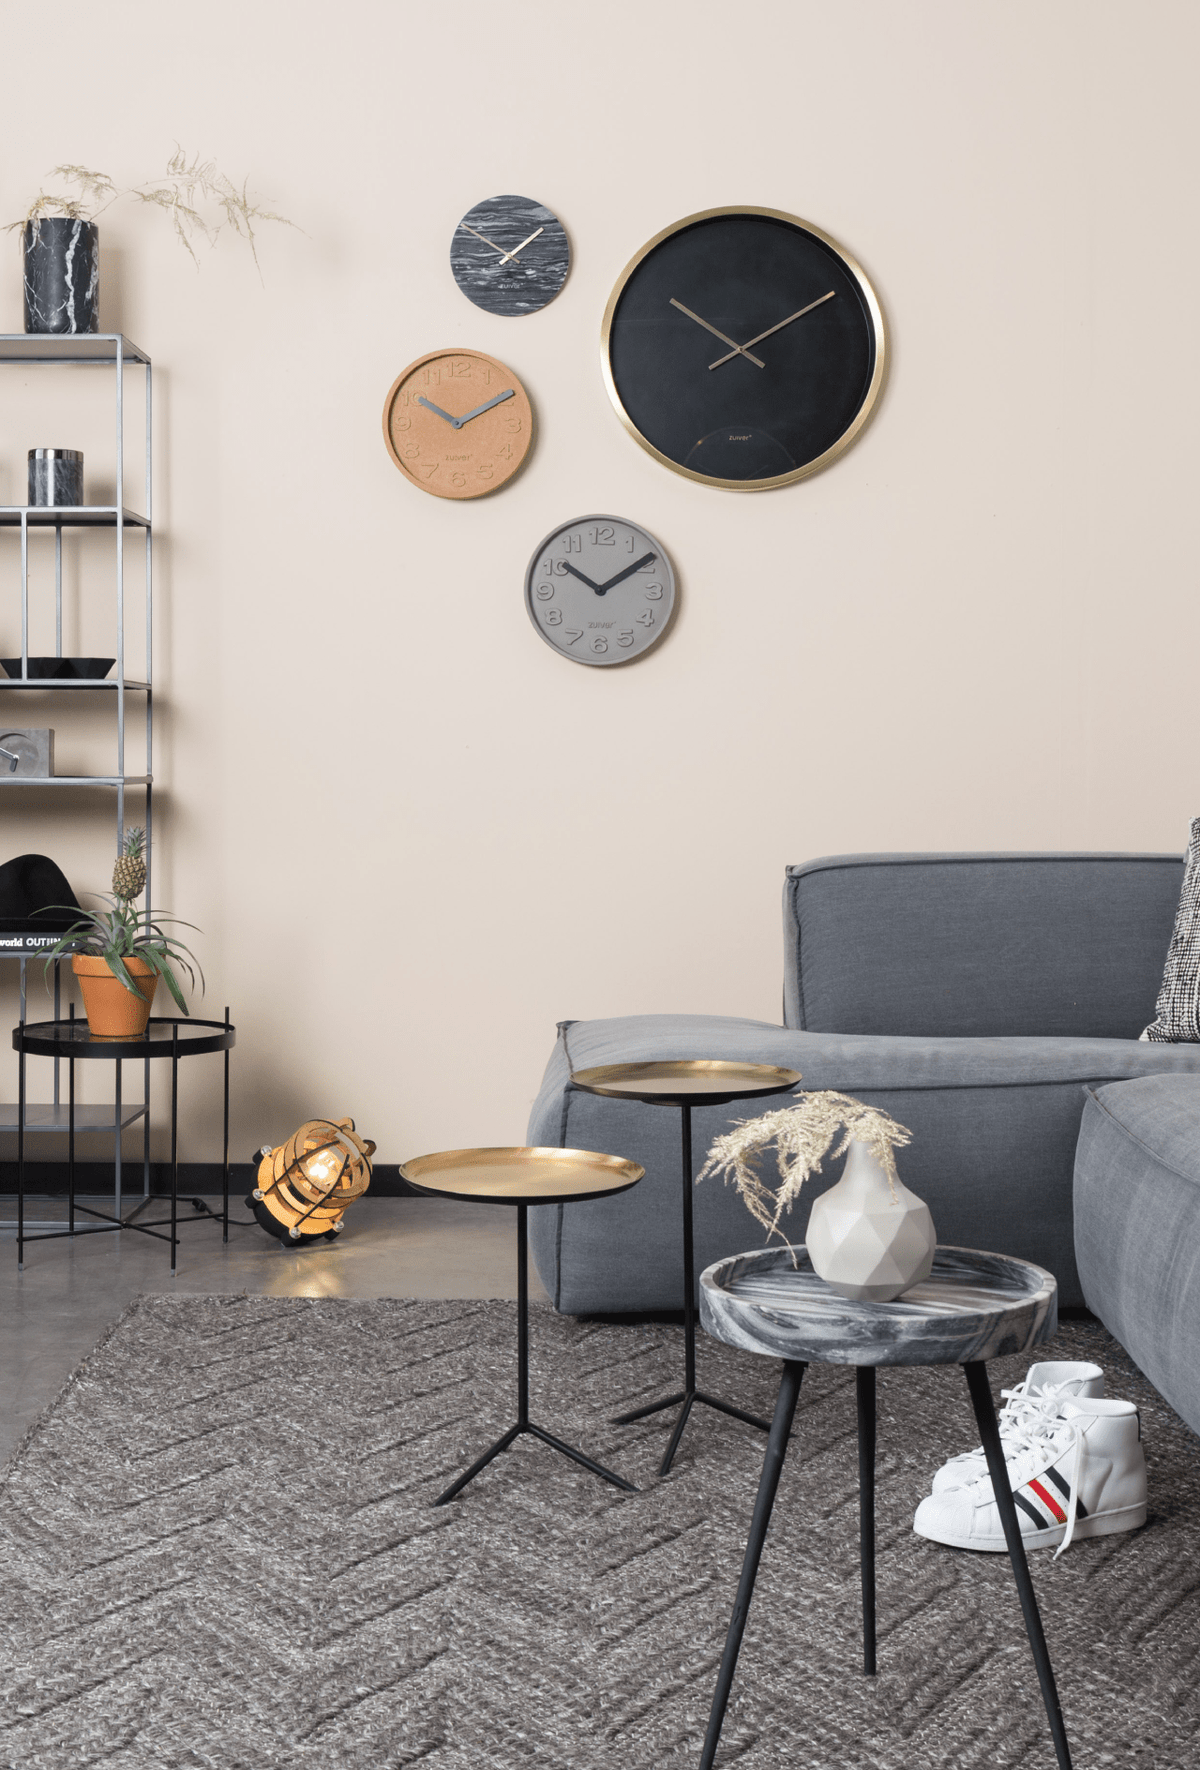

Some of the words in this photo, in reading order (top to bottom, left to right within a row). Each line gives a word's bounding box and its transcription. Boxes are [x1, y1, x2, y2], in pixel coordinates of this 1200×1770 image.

[422, 368, 441, 386] 11
[446, 361, 471, 378] 12
[482, 368, 491, 386] 1
[394, 416, 412, 432] 9
[504, 418, 522, 434] 3
[404, 443, 420, 459] 8
[496, 443, 514, 460] 4
[421, 463, 439, 479] 7
[451, 472, 467, 488] 6
[477, 463, 494, 480] 5
[562, 534, 581, 553] 11
[589, 526, 616, 546] 12
[625, 535, 635, 554] 1
[543, 557, 570, 576] 10
[536, 582, 555, 601] 9
[644, 582, 663, 601] 3
[545, 608, 563, 626] 8
[635, 608, 655, 627] 4
[565, 628, 584, 646] 7
[589, 635, 609, 654] 6
[617, 629, 635, 648] 5
